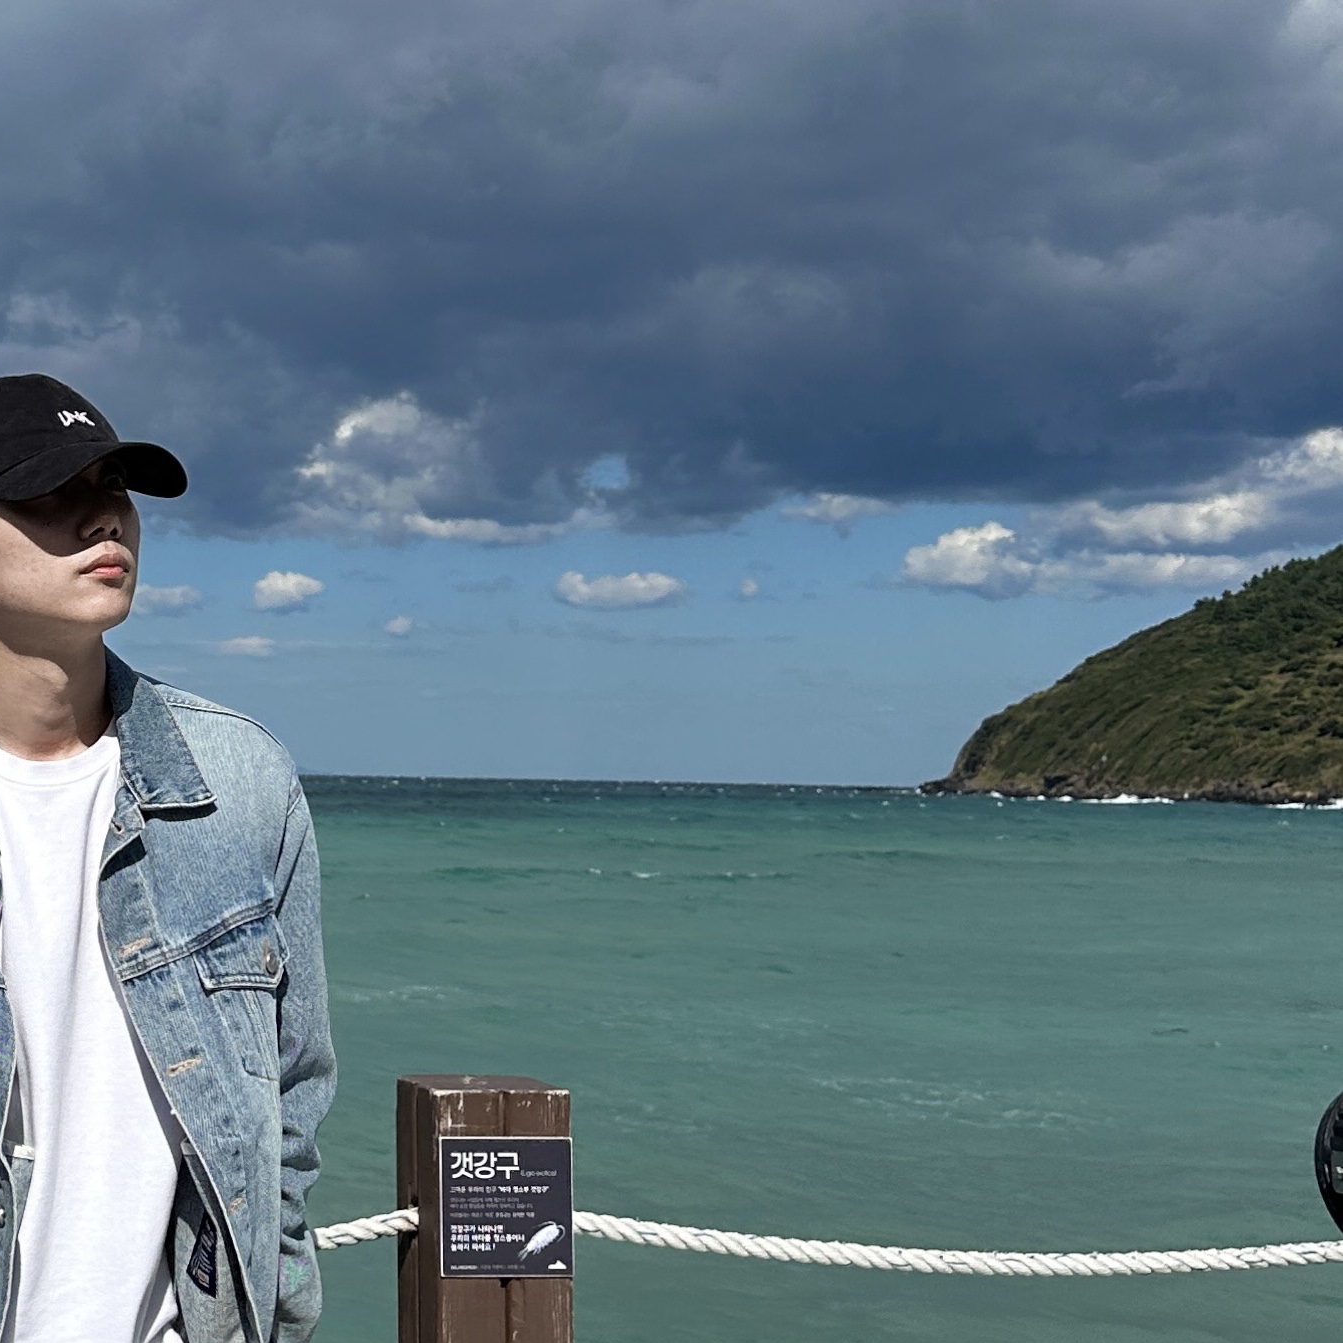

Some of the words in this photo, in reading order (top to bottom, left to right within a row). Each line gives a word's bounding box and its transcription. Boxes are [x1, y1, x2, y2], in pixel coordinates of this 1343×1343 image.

[449, 1152, 520, 1180] 갯강구
[450, 1224, 476, 1233] 갯강구가
[477, 1224, 504, 1233] 나타나면
[450, 1234, 469, 1242] 우리의
[471, 1234, 491, 1242] 바다를
[450, 1243, 469, 1252] 놀라지
